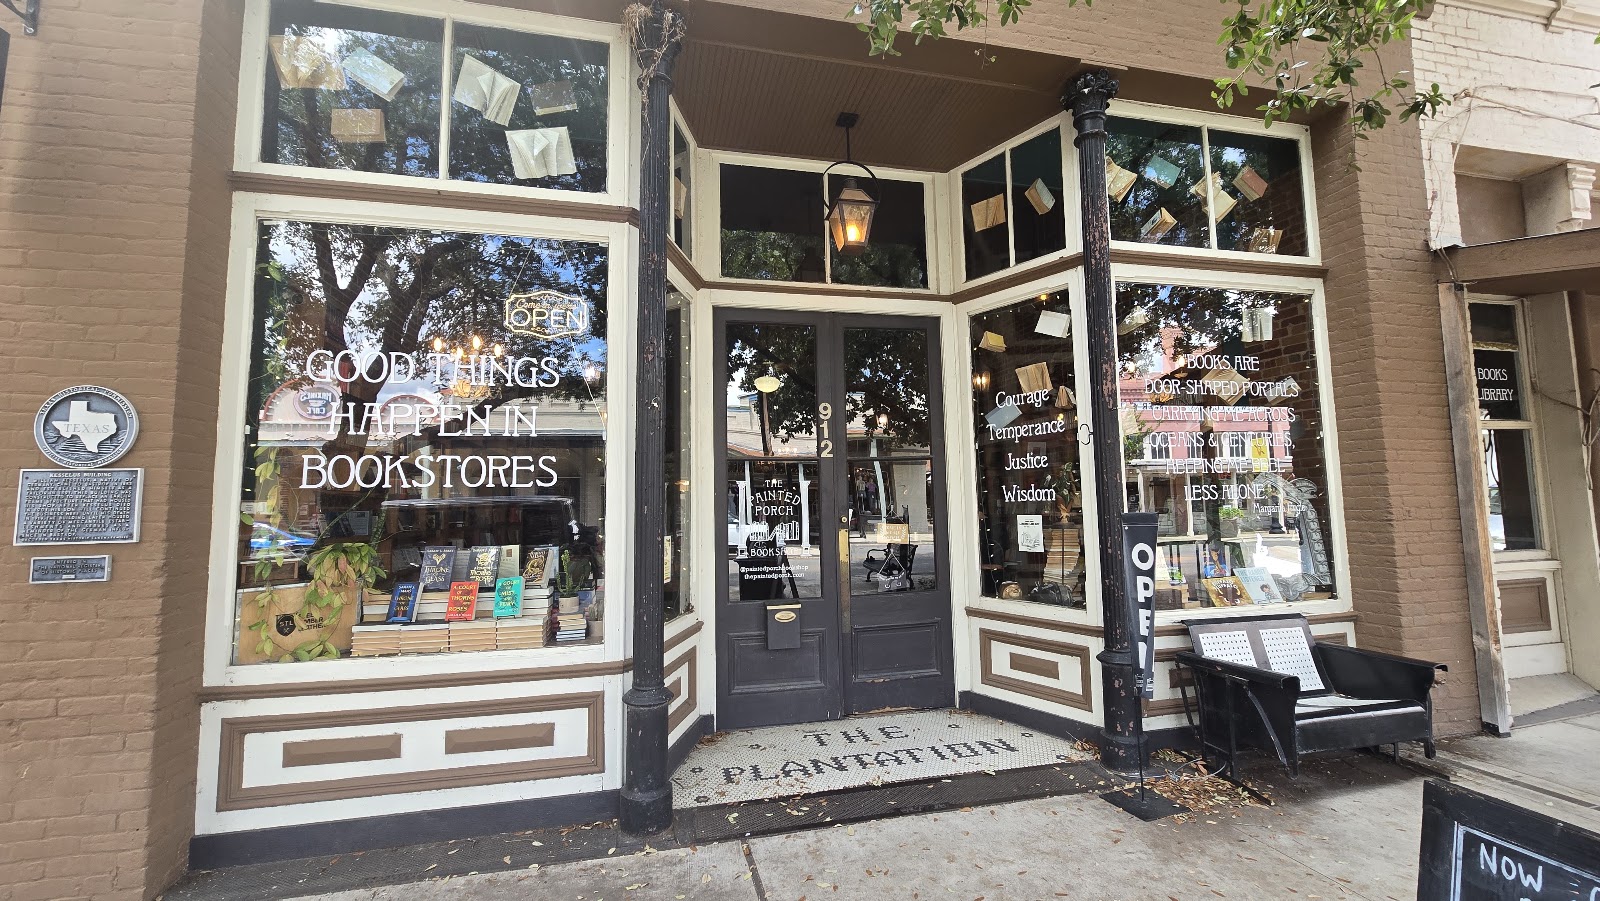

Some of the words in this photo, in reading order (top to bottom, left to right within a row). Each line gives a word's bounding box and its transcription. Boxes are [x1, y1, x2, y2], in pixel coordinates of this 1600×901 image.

[510, 308, 583, 329] OPEN
[306, 350, 414, 384] GOOD
[429, 351, 560, 388] THINGS
[1235, 356, 1260, 371] ARE
[1477, 367, 1508, 381] BOOKS
[1145, 378, 1239, 397] DOOR-SHAPED
[1242, 381, 1298, 398] PORTALS
[995, 388, 1050, 409] Courage
[327, 402, 492, 437] HAPPEN
[503, 405, 538, 437] IN
[1151, 405, 1219, 422] CARRYING
[1224, 406, 1244, 422] ME
[1247, 406, 1296, 423] ACROSS
[64, 423, 110, 434] TEXAS
[818, 402, 834, 458] 912
[986, 419, 1065, 443] Temperance
[1149, 431, 1204, 447] OCEANS
[1208, 432, 1217, 447] &
[1005, 452, 1048, 471] Justice
[1166, 457, 1223, 474] HELPING
[1227, 458, 1248, 473] ME
[300, 454, 558, 489] BOOKSTORES
[765, 479, 783, 488] THE
[1001, 484, 1056, 502] Wisdom
[1184, 485, 1219, 501] LESS
[748, 490, 801, 506] PAINTED
[755, 505, 794, 516] PORCH
[803, 726, 909, 747] THE
[720, 737, 1020, 784] PLANTATION
[1479, 842, 1543, 893] NOW
